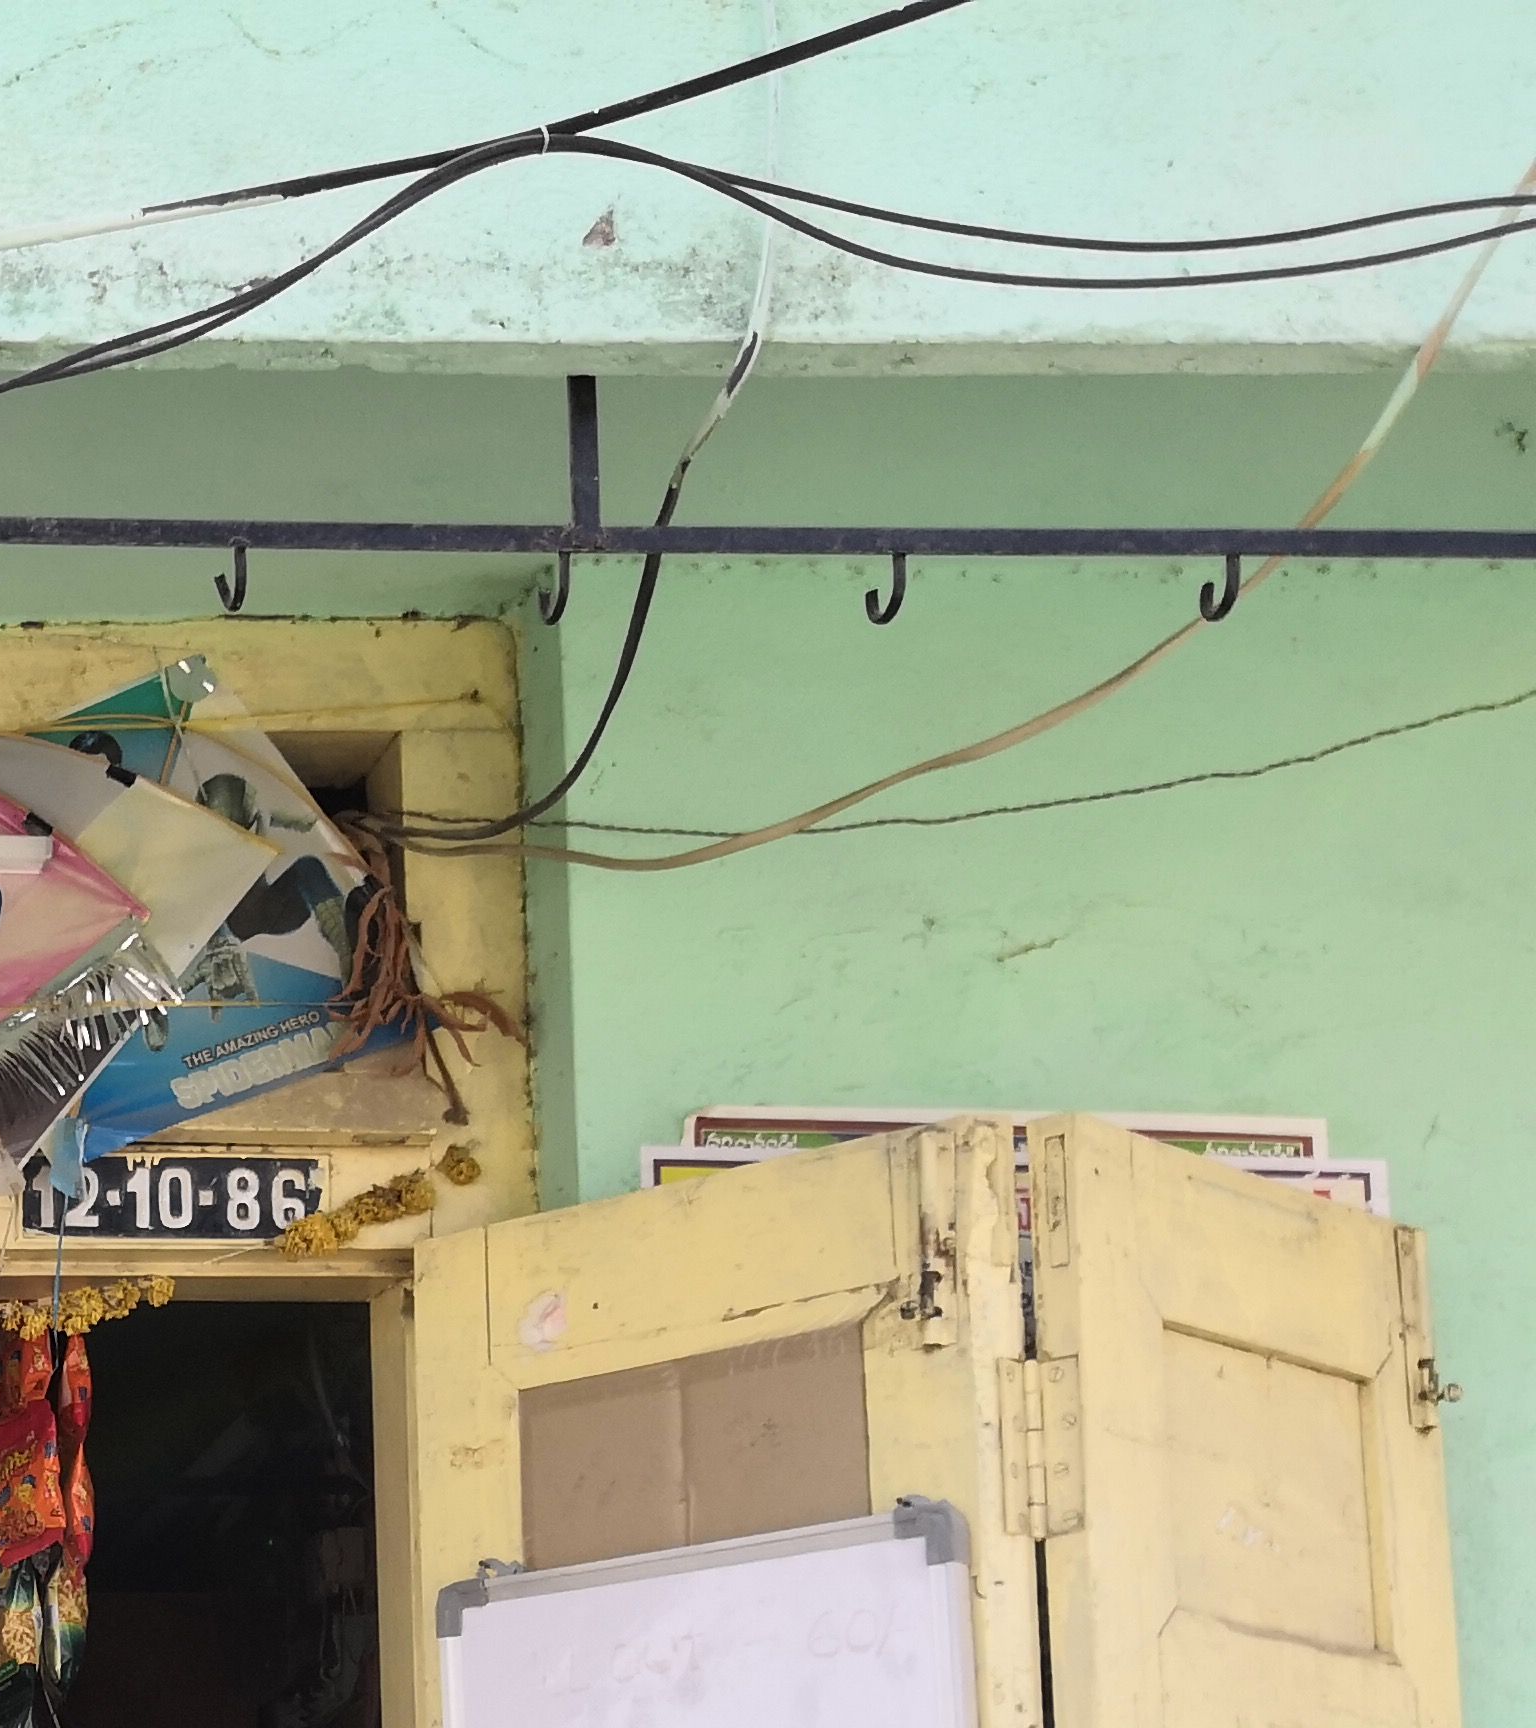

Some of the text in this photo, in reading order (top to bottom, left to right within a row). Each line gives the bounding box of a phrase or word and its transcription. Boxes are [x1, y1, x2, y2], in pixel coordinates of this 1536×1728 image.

[183, 1011, 320, 1068] THE AMAZING HERO
